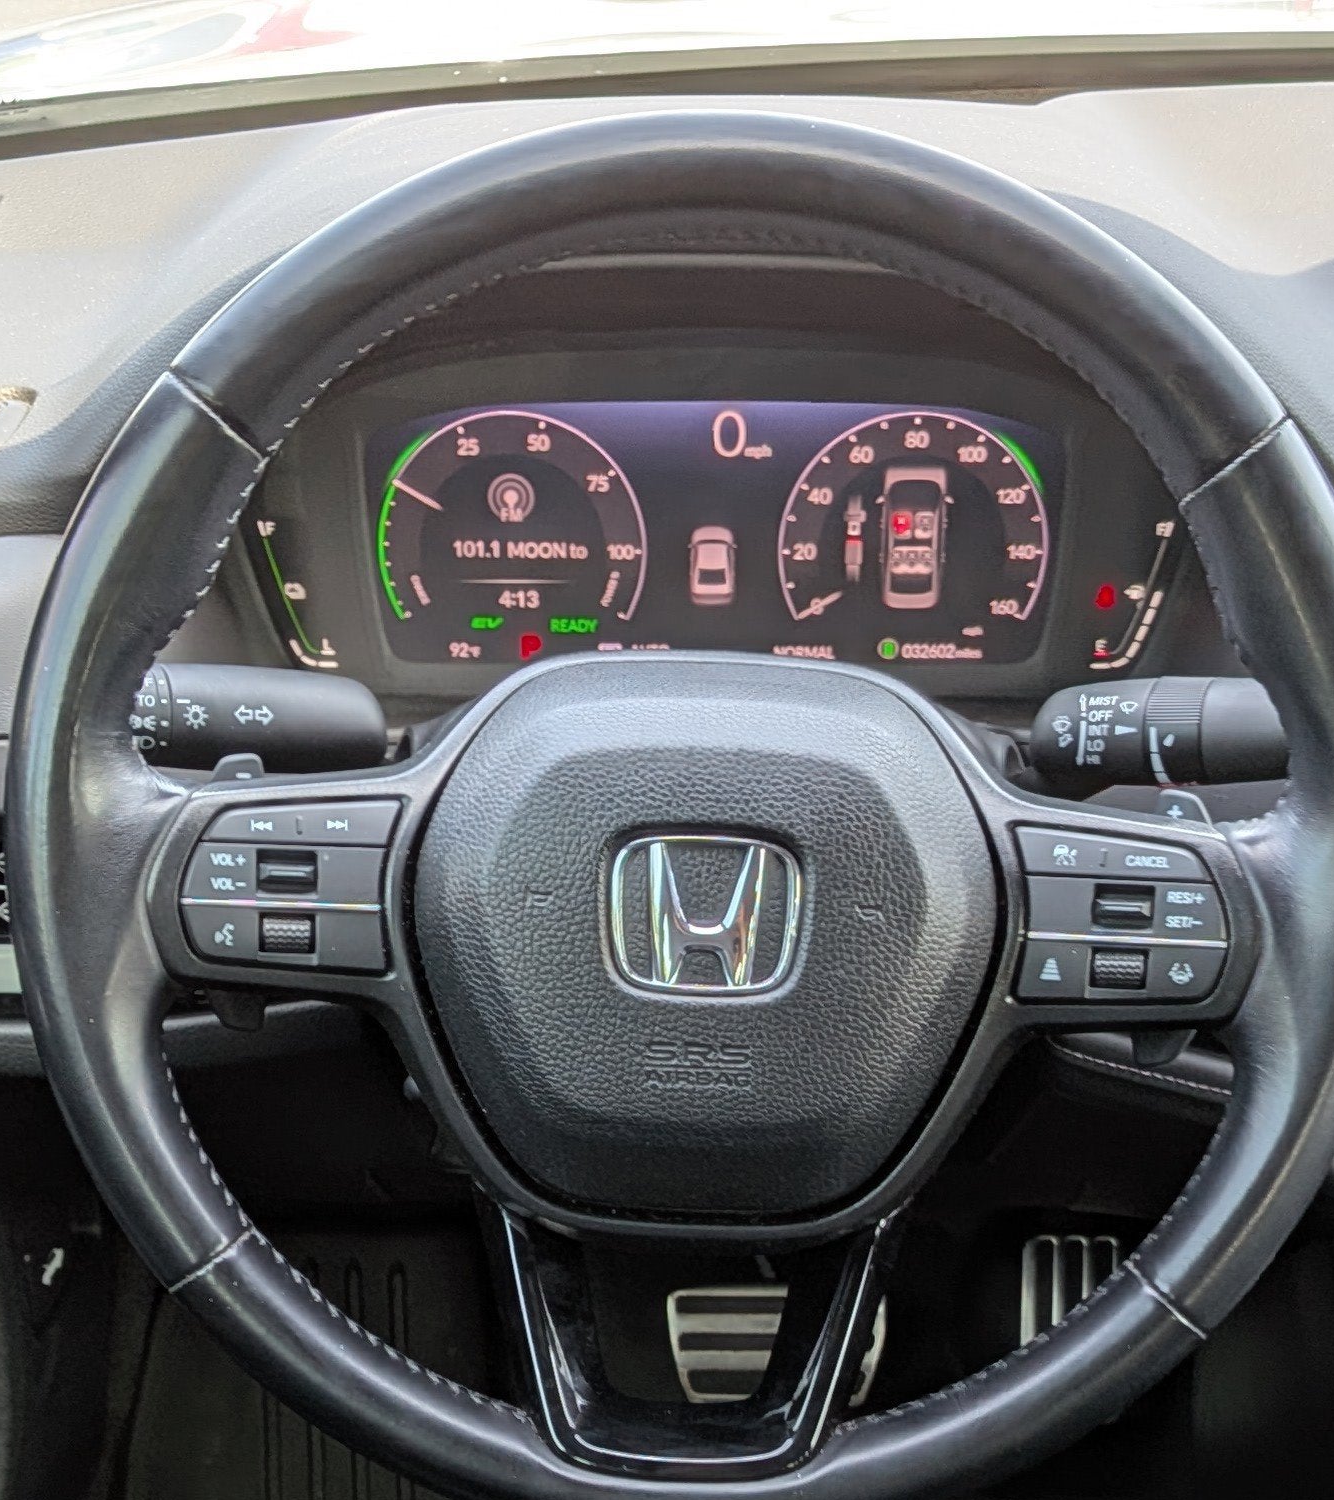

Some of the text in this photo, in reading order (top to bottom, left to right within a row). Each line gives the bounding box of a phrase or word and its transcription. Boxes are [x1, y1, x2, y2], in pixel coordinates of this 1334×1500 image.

[712, 410, 748, 458] 0
[904, 430, 930, 449] 80
[456, 437, 480, 457] 25
[526, 434, 551, 452] 50
[848, 446, 875, 464] 60
[957, 446, 988, 463] 100
[585, 475, 610, 494] 75
[807, 487, 833, 505] 40
[996, 488, 1026, 504] 120
[499, 508, 524, 523] FM
[452, 540, 588, 560] 101.1 MOON to
[607, 545, 635, 561] 100
[792, 543, 817, 561] 20
[1007, 544, 1036, 560] 140
[497, 590, 541, 610] 4:13
[989, 600, 1018, 614] 160
[549, 618, 599, 633] READY
[520, 634, 542, 660] P
[901, 643, 957, 659] 032602
[1088, 695, 1119, 706] MIST
[1088, 709, 1114, 722] OFF
[1088, 724, 1109, 736] INT
[1087, 739, 1106, 752] LO
[1124, 855, 1170, 868] CANCEL
